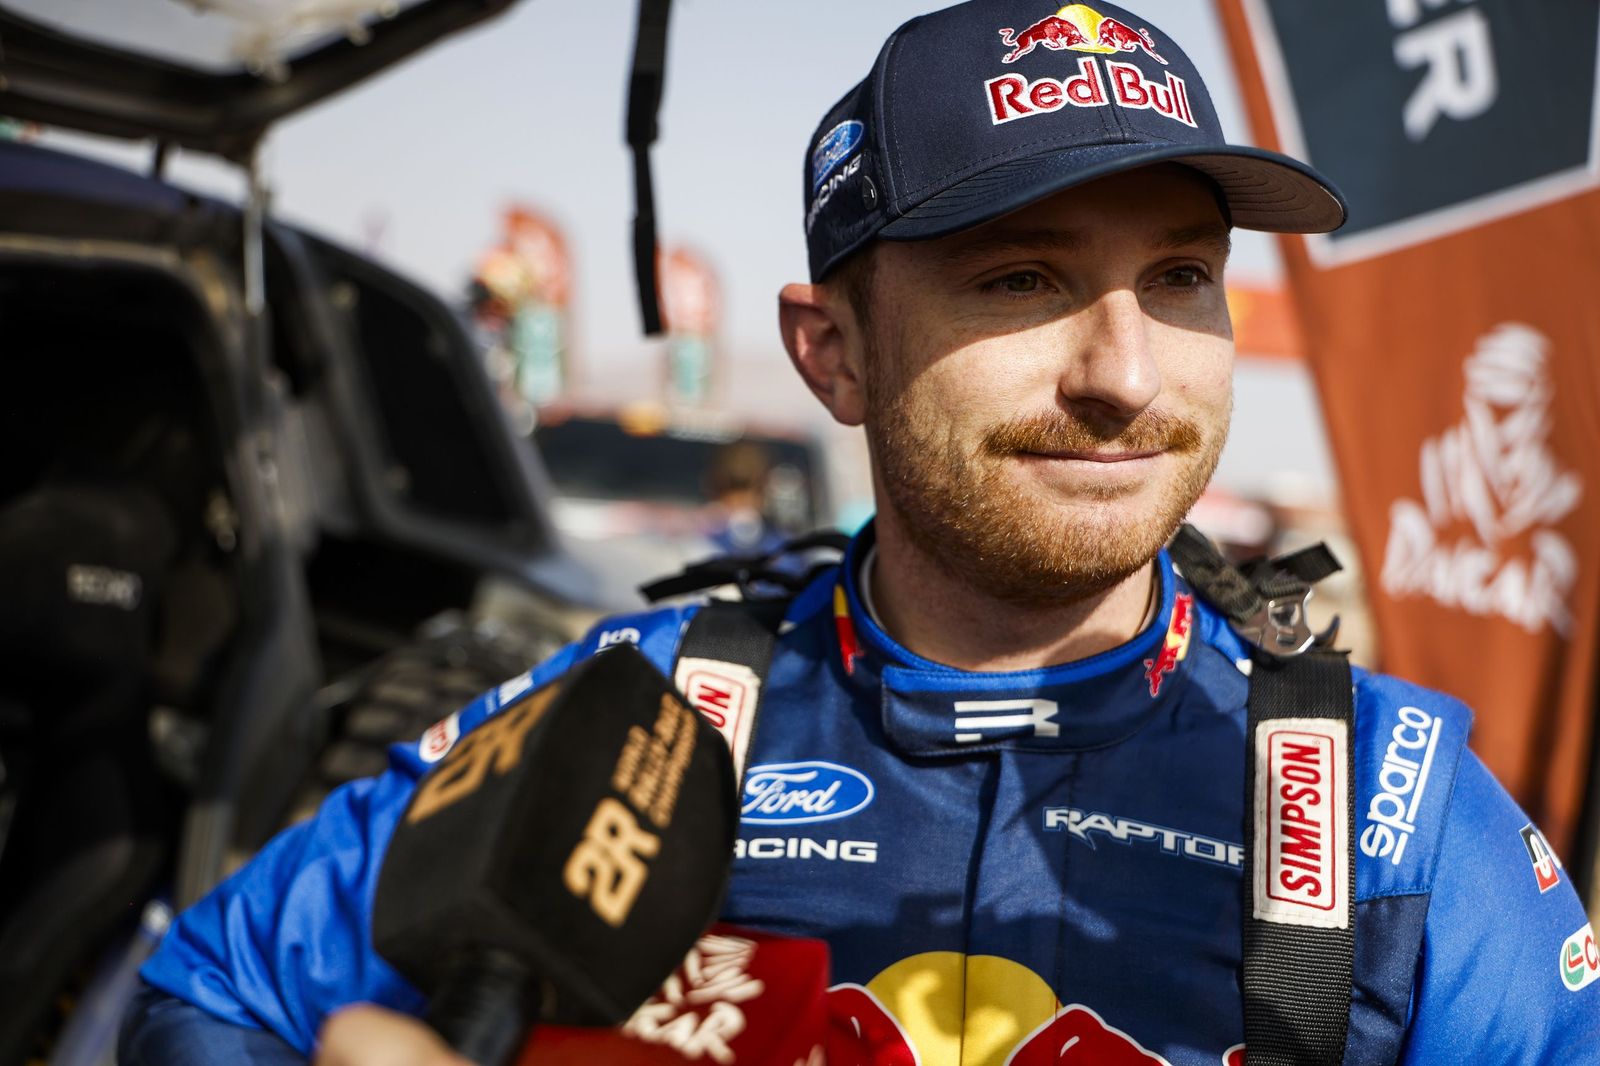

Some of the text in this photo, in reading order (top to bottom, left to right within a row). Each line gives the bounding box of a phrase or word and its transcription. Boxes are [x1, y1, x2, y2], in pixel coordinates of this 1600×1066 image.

[986, 58, 1196, 127] Red Bull
[740, 769, 842, 816] Ford
[1279, 741, 1322, 898] SIMPSON
[1360, 705, 1433, 859] sparco
[562, 796, 662, 928] 2R
[734, 837, 878, 864] CING
